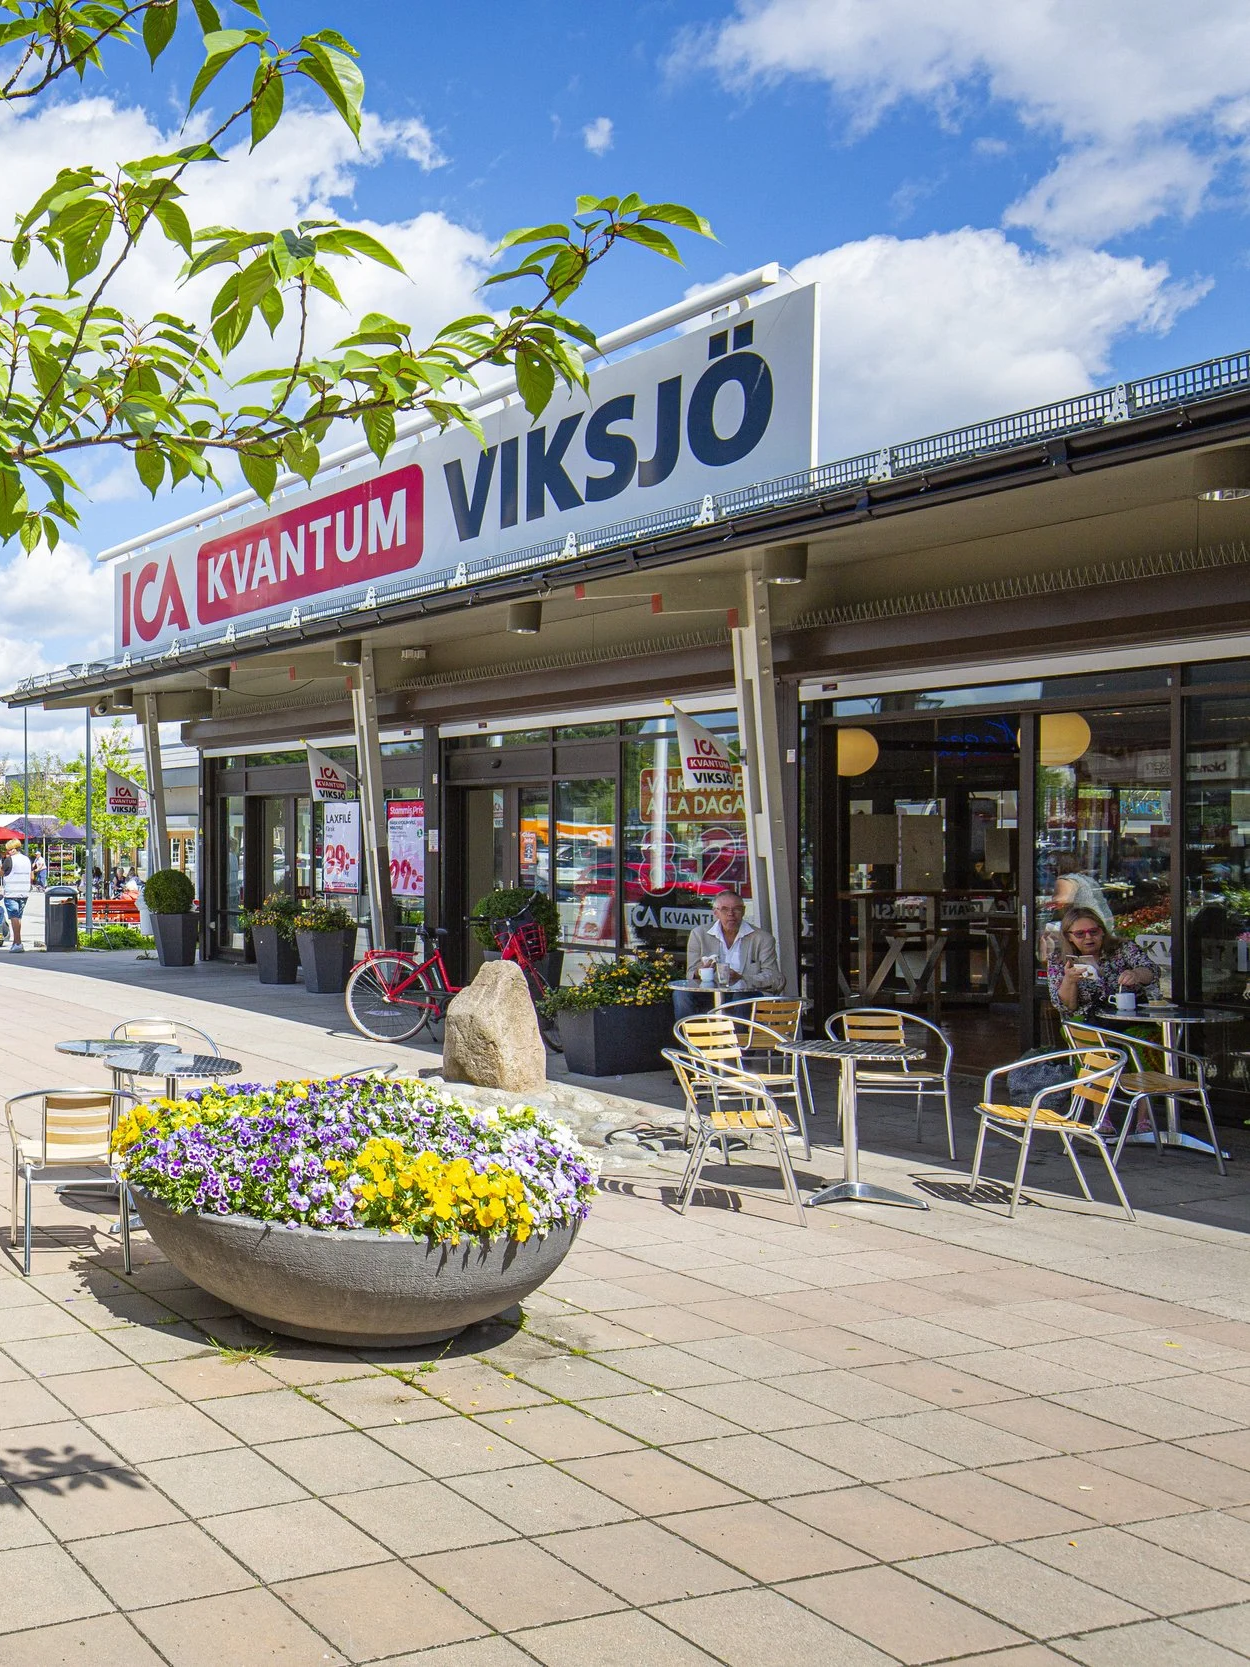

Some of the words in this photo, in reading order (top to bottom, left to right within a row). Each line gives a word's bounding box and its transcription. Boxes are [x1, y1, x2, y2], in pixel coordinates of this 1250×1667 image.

[122, 554, 190, 648] ICA
[207, 488, 407, 603] KVANTUM
[443, 319, 774, 542] VIKSJÖ
[693, 738, 721, 757] ICA
[690, 759, 730, 770] KVANTUM
[319, 766, 340, 780] ICA
[692, 772, 735, 785] VIKSJÖ
[316, 780, 345, 789] KVANTUM
[115, 787, 133, 797] ICA
[319, 790, 346, 800] VIKSJÖ
[111, 805, 137, 813] VIKSJÖ
[646, 796, 690, 815] ALA
[693, 795, 746, 815] DAGA
[326, 811, 352, 824] LAXFILÉ
[664, 911, 714, 926] KVANT
